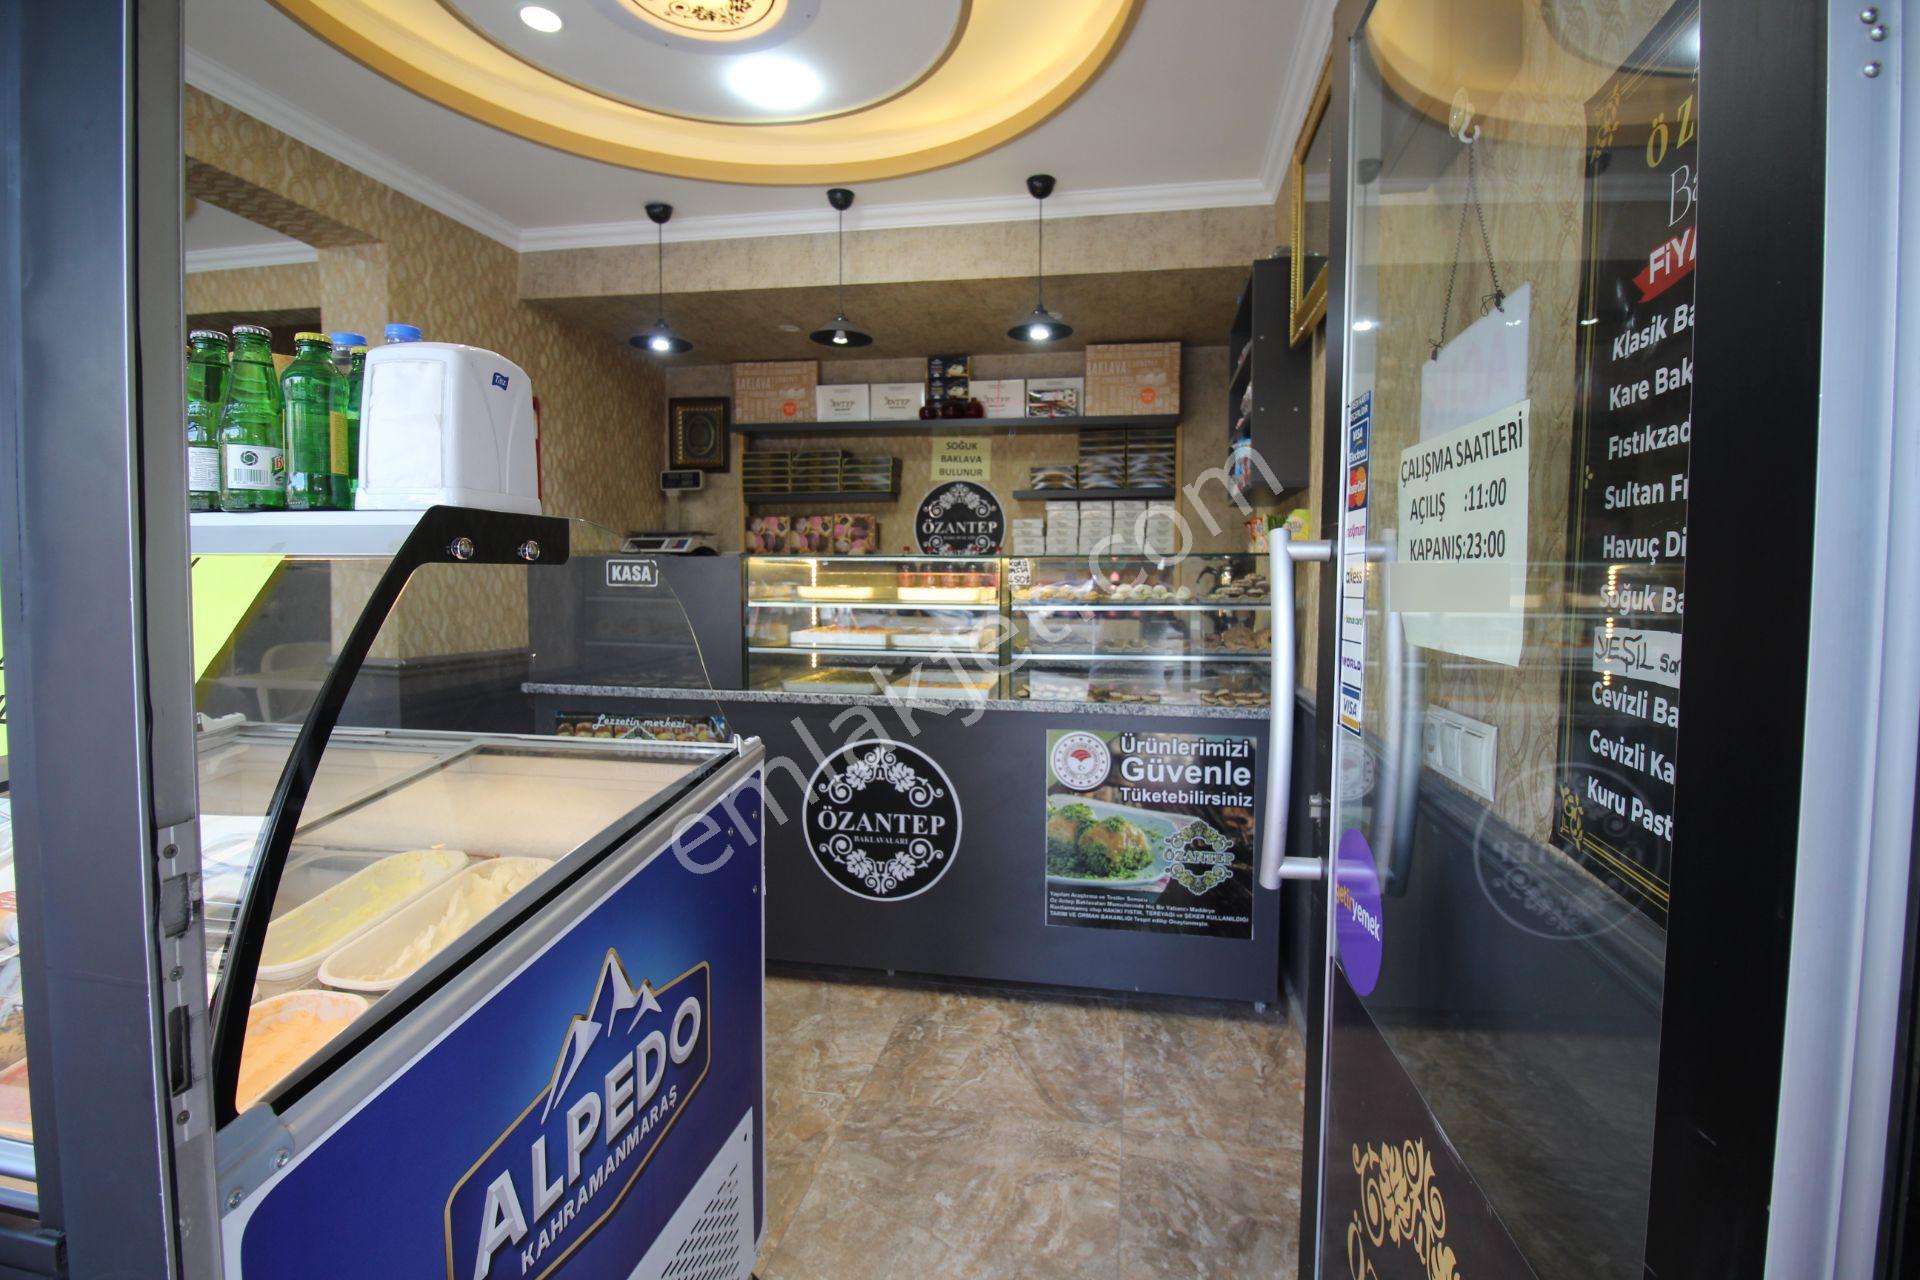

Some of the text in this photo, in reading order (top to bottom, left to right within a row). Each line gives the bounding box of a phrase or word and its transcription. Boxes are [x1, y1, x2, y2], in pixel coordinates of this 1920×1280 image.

[1612, 314, 1667, 361] Klasik
[1609, 379, 1649, 411] Kare
[940, 455, 982, 463] BAKLAVA
[946, 440, 977, 450] SOĞUK
[1400, 411, 1523, 488] ÇALIŞMA SAATLERİ
[939, 468, 983, 477] BULUNUR
[1410, 492, 1446, 525] AÇILIŞ
[1604, 481, 1664, 510] Sultan
[922, 519, 998, 534] ÖZANTEP
[1603, 535, 1659, 565] Havuç
[611, 565, 652, 582] KASA
[1600, 583, 1655, 615] Soğuk
[1343, 699, 1357, 717] VISA
[1591, 681, 1649, 719] Cevizli
[592, 714, 686, 729] Lezzetin merkezi
[1121, 732, 1249, 758] Ürünlerimizi
[1589, 729, 1675, 785] Cevizli Ka
[1121, 756, 1251, 786] Güvenle
[1120, 787, 1253, 807] Tüketebilirsiniz
[1587, 776, 1673, 841] Kuru Past
[817, 805, 946, 836] ÖZANTEP
[854, 835, 908, 845] BAKLAVALARI
[1163, 848, 1235, 865] ÖZANTEP
[473, 996, 701, 1280] ALPEDO
[521, 1085, 678, 1276] KAHRAMANMARAŞ
